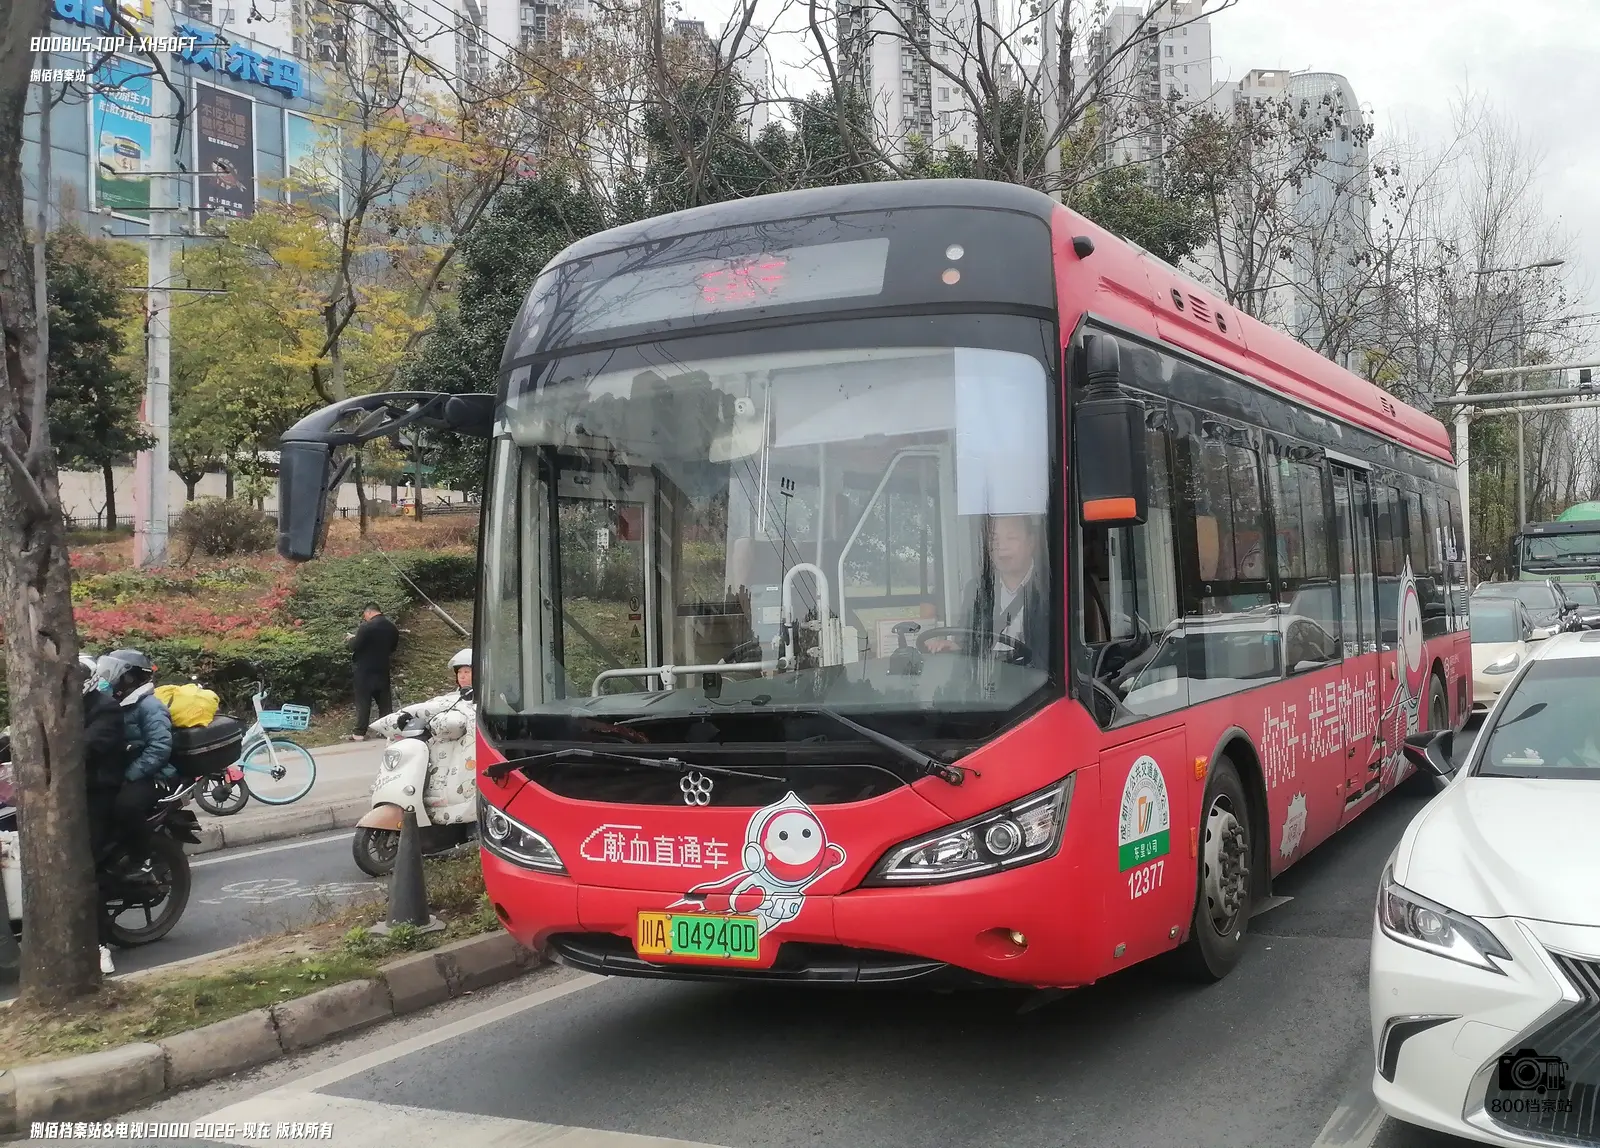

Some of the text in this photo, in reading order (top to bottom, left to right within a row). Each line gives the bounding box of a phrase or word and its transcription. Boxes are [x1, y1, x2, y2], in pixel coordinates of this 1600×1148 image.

[603, 831, 729, 869] 献血直通车
[1128, 860, 1165, 900] 12377
